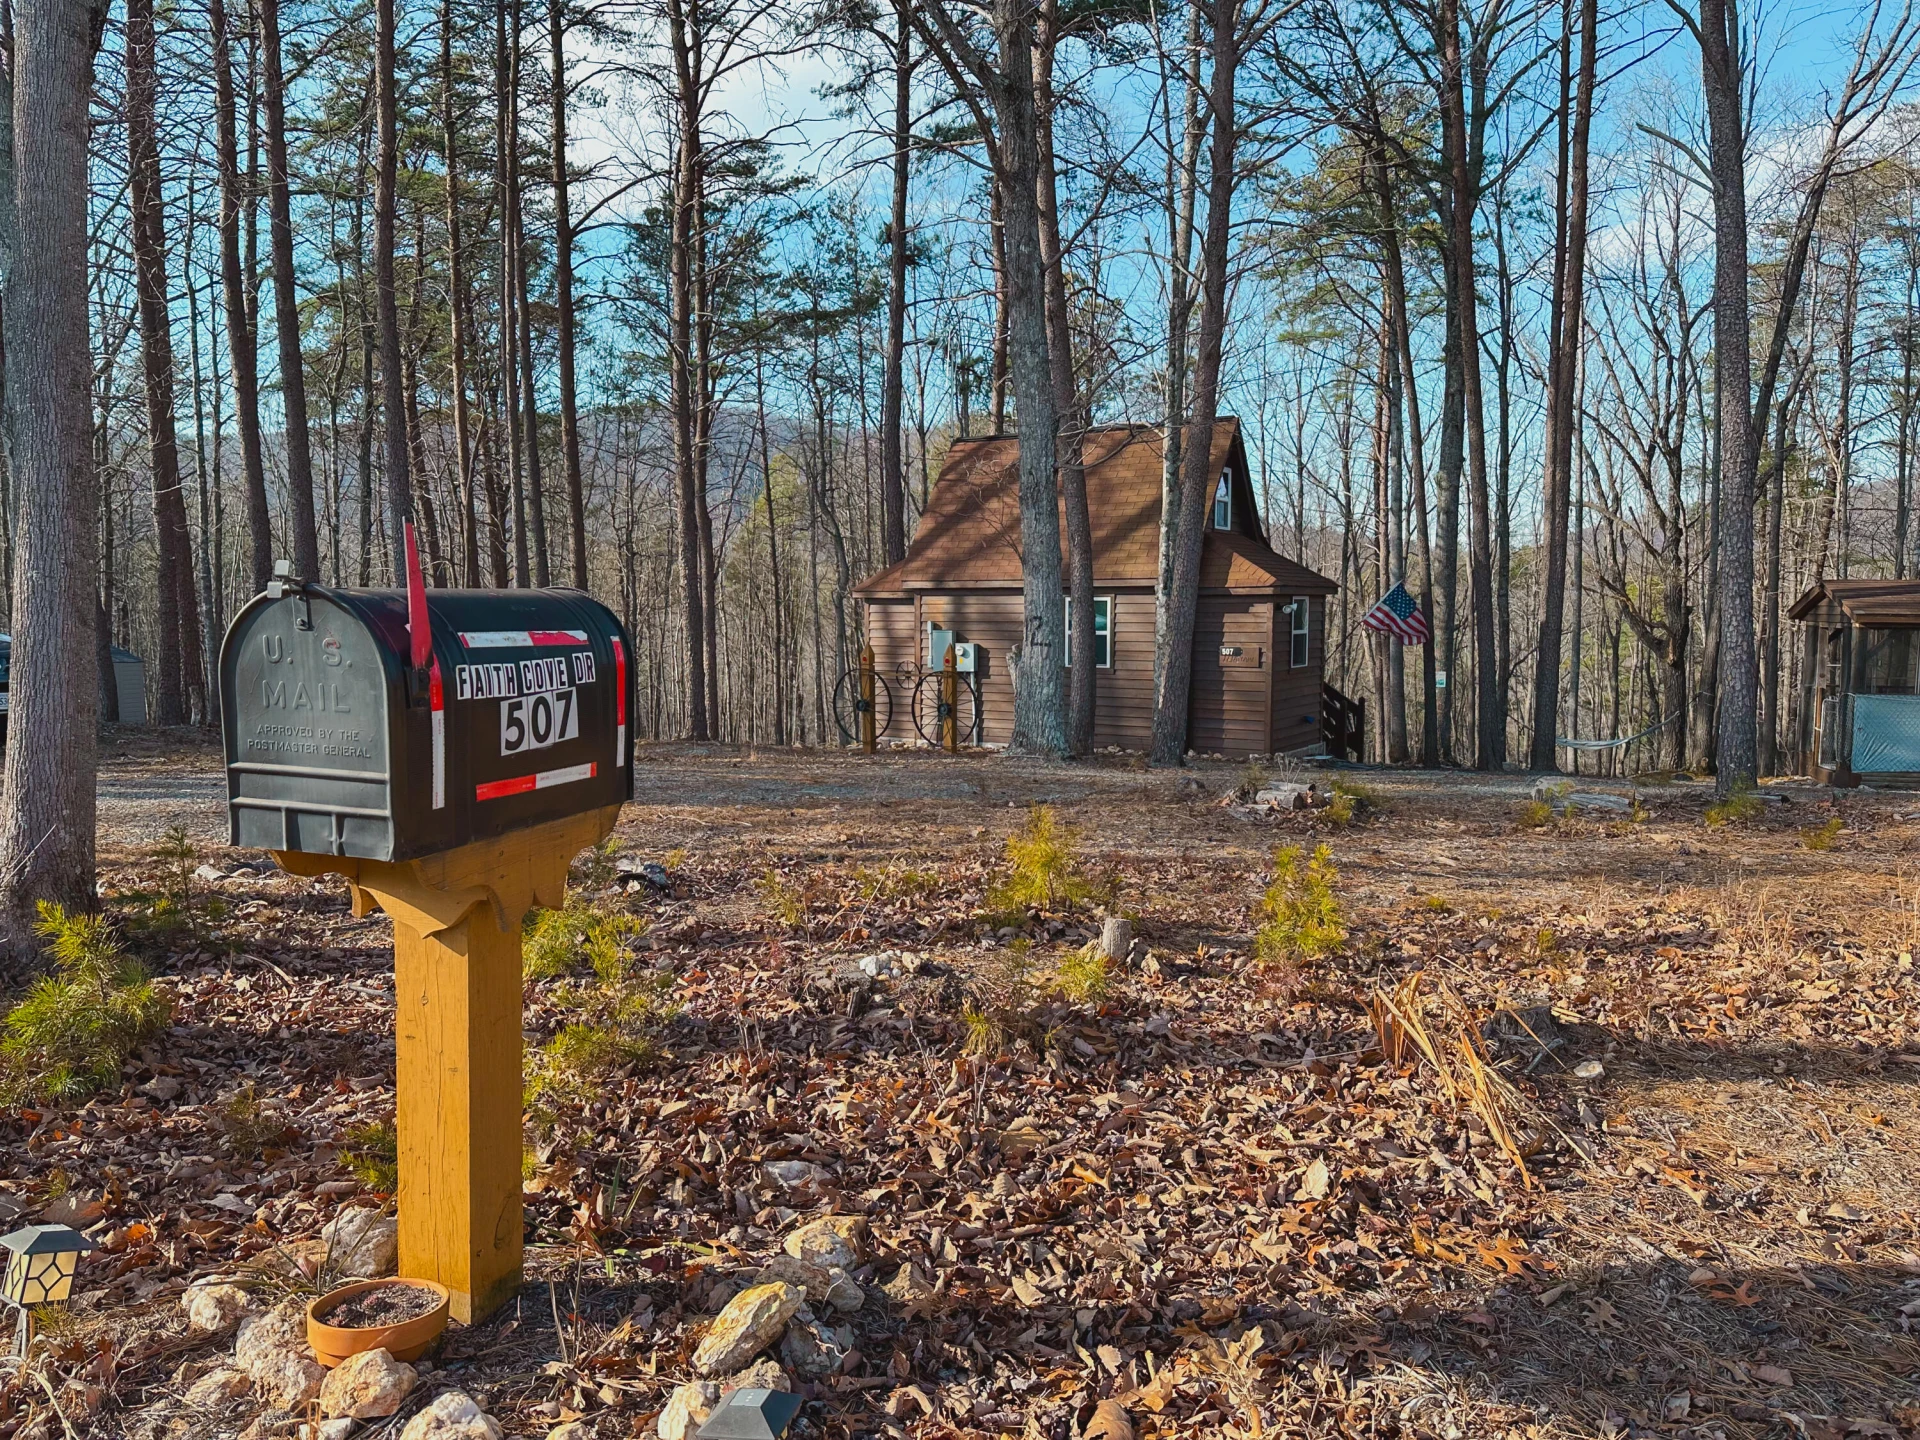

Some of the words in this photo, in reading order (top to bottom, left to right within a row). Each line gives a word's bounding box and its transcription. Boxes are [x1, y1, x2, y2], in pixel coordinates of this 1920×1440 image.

[262, 634, 293, 664] U.
[321, 637, 352, 667] S.
[458, 665, 516, 698] FAITH
[522, 659, 568, 691] COVE
[575, 654, 595, 682] DR
[262, 679, 351, 713] MAIL
[257, 724, 313, 738] APPROVED
[319, 729, 333, 740] BY
[339, 729, 360, 742] THE
[504, 690, 573, 752] 507
[247, 738, 318, 755] POSTMASTER
[323, 744, 372, 759] GENERAL
